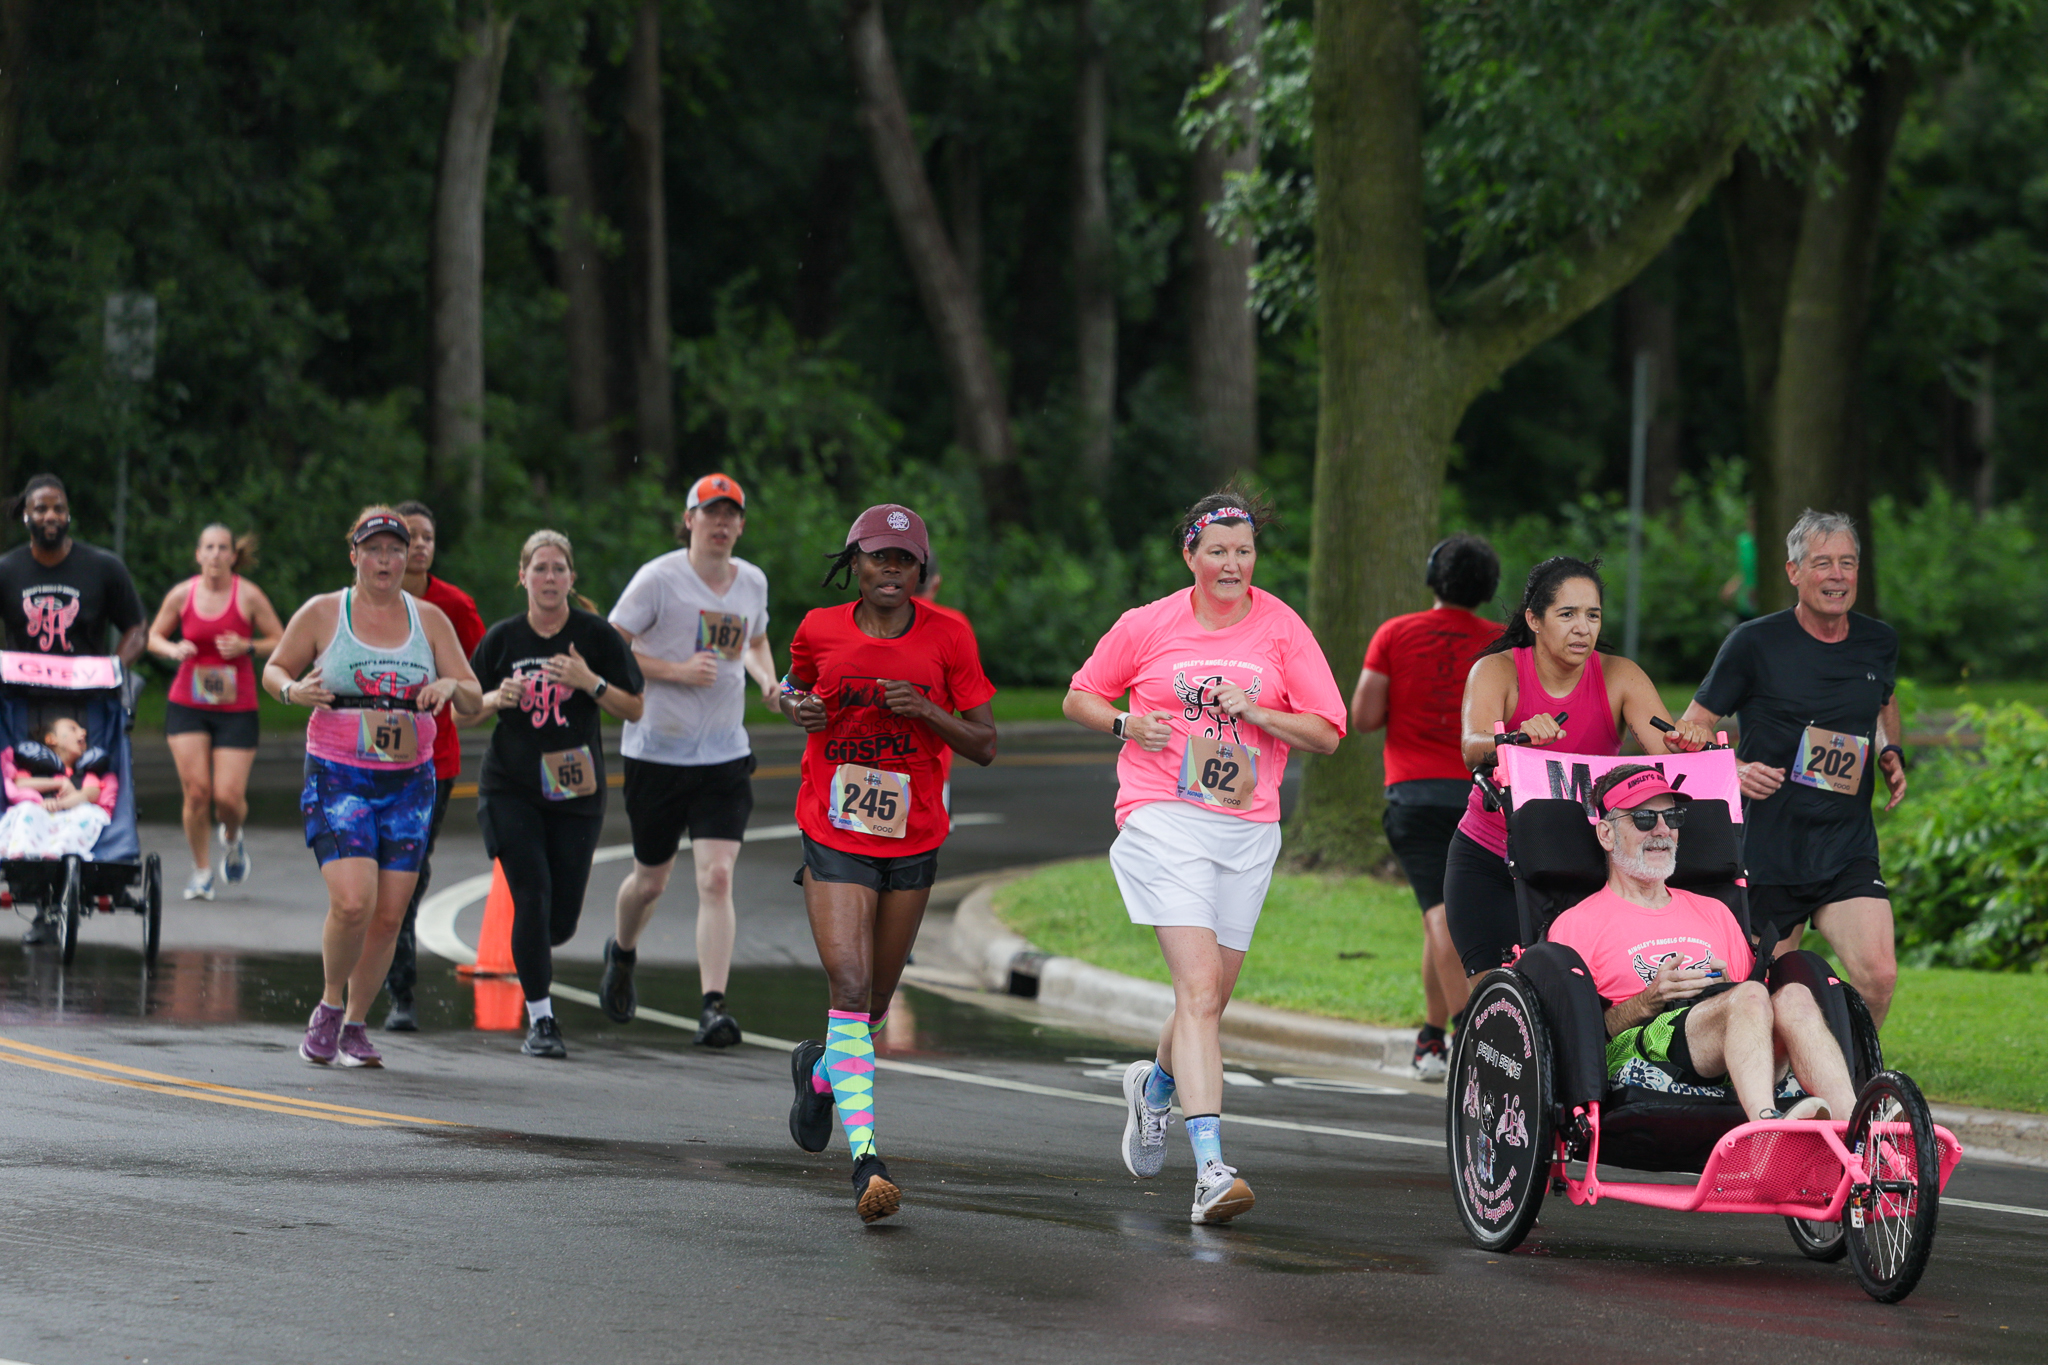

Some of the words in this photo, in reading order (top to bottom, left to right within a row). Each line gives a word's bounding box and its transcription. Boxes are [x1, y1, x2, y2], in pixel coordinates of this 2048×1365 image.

[710, 624, 741, 648] 187
[18, 661, 97, 683] Gray
[1172, 659, 1205, 671] AINSLEY'S
[1205, 658, 1229, 667] ANGELS
[1238, 660, 1264, 674] AMERICA
[375, 725, 402, 750] 51
[840, 718, 904, 736] MADISON
[824, 734, 917, 761] GOSPEL
[1806, 745, 1856, 780] 202
[558, 762, 584, 787] 55
[1201, 758, 1239, 793] 62
[1627, 773, 1656, 790] AINSLEY'S
[1834, 782, 1850, 791] FOOD
[842, 782, 899, 821] 245
[1223, 797, 1241, 806] FOOD
[873, 824, 893, 834] FOOD
[1627, 940, 1656, 956] AINSLEY'S
[1656, 936, 1678, 946] ANGELS
[1687, 936, 1712, 949] AMERICA
